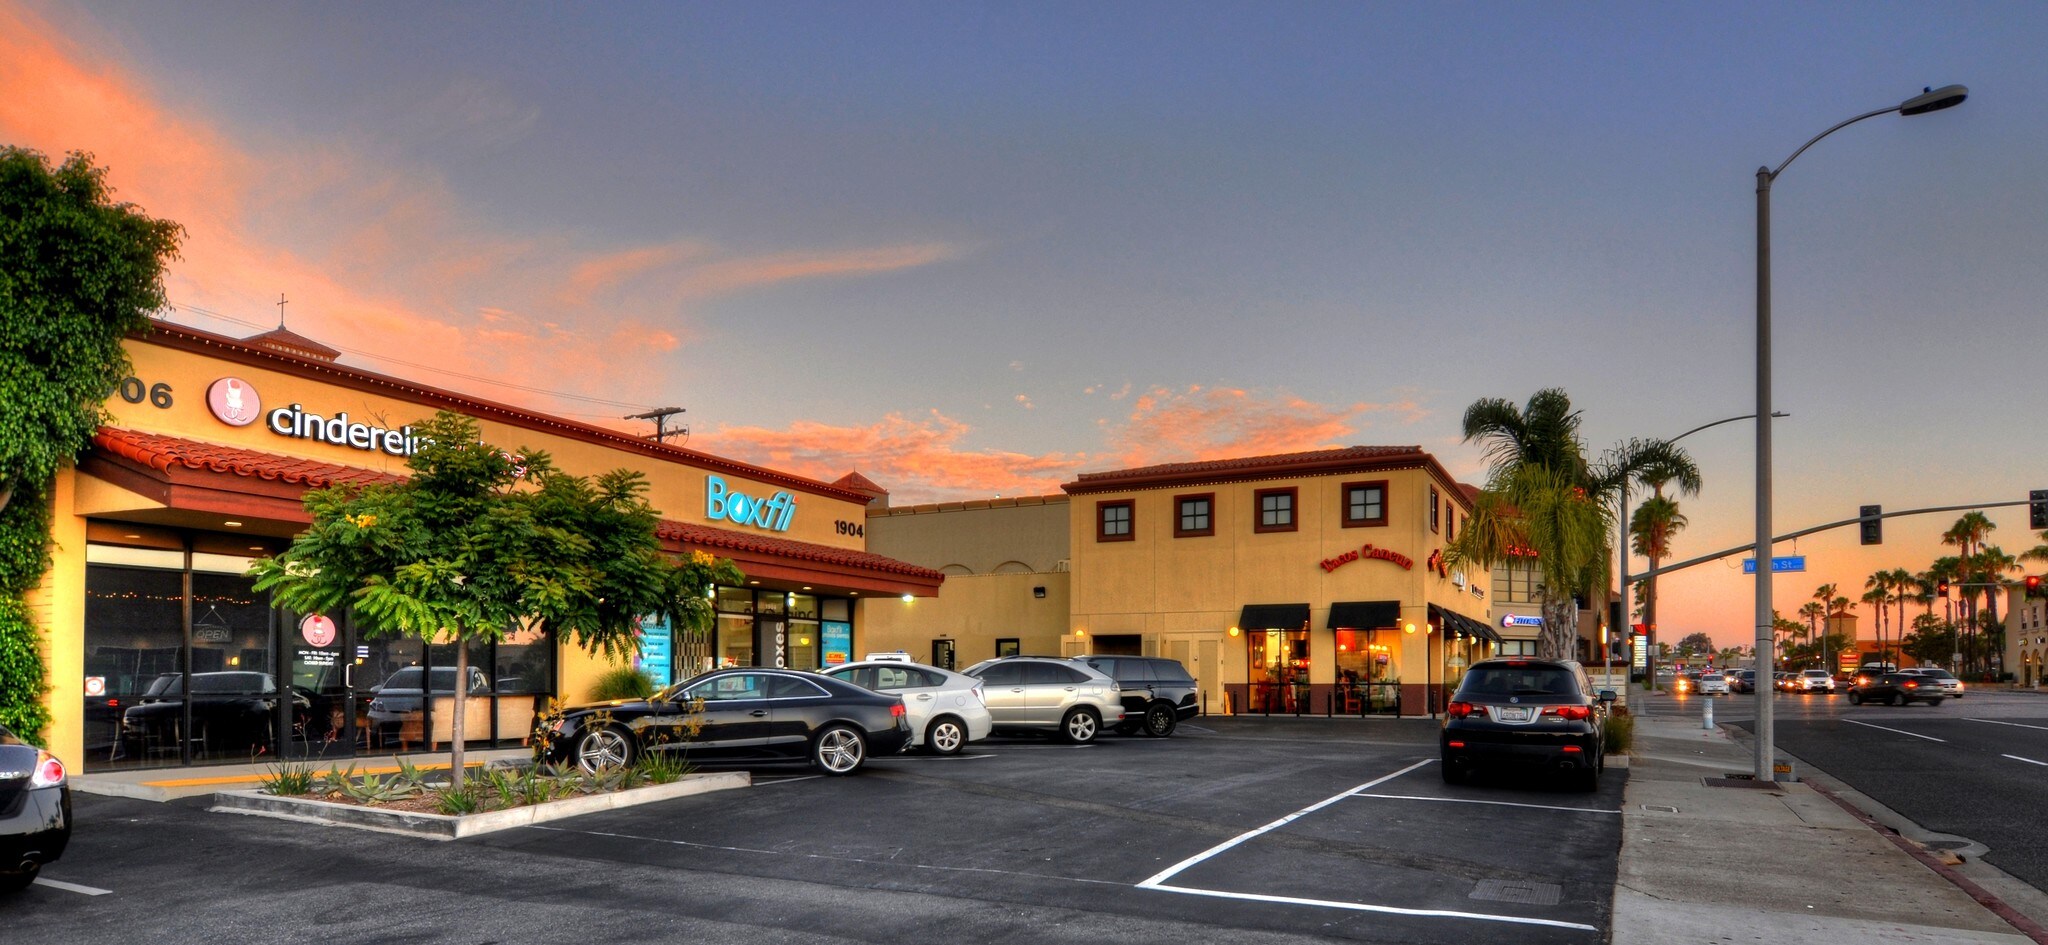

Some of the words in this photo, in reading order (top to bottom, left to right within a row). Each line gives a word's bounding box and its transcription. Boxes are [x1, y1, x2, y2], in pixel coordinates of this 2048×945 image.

[108, 376, 173, 409] 06
[705, 474, 799, 531] Boxfli
[834, 519, 864, 538] 1904
[1320, 550, 1359, 573] Tacos
[1361, 544, 1414, 571] Cancun
[1745, 562, 1755, 571] W
[1781, 560, 1793, 569] St
[195, 629, 229, 639] OPEN
[775, 622, 785, 668] oxes
